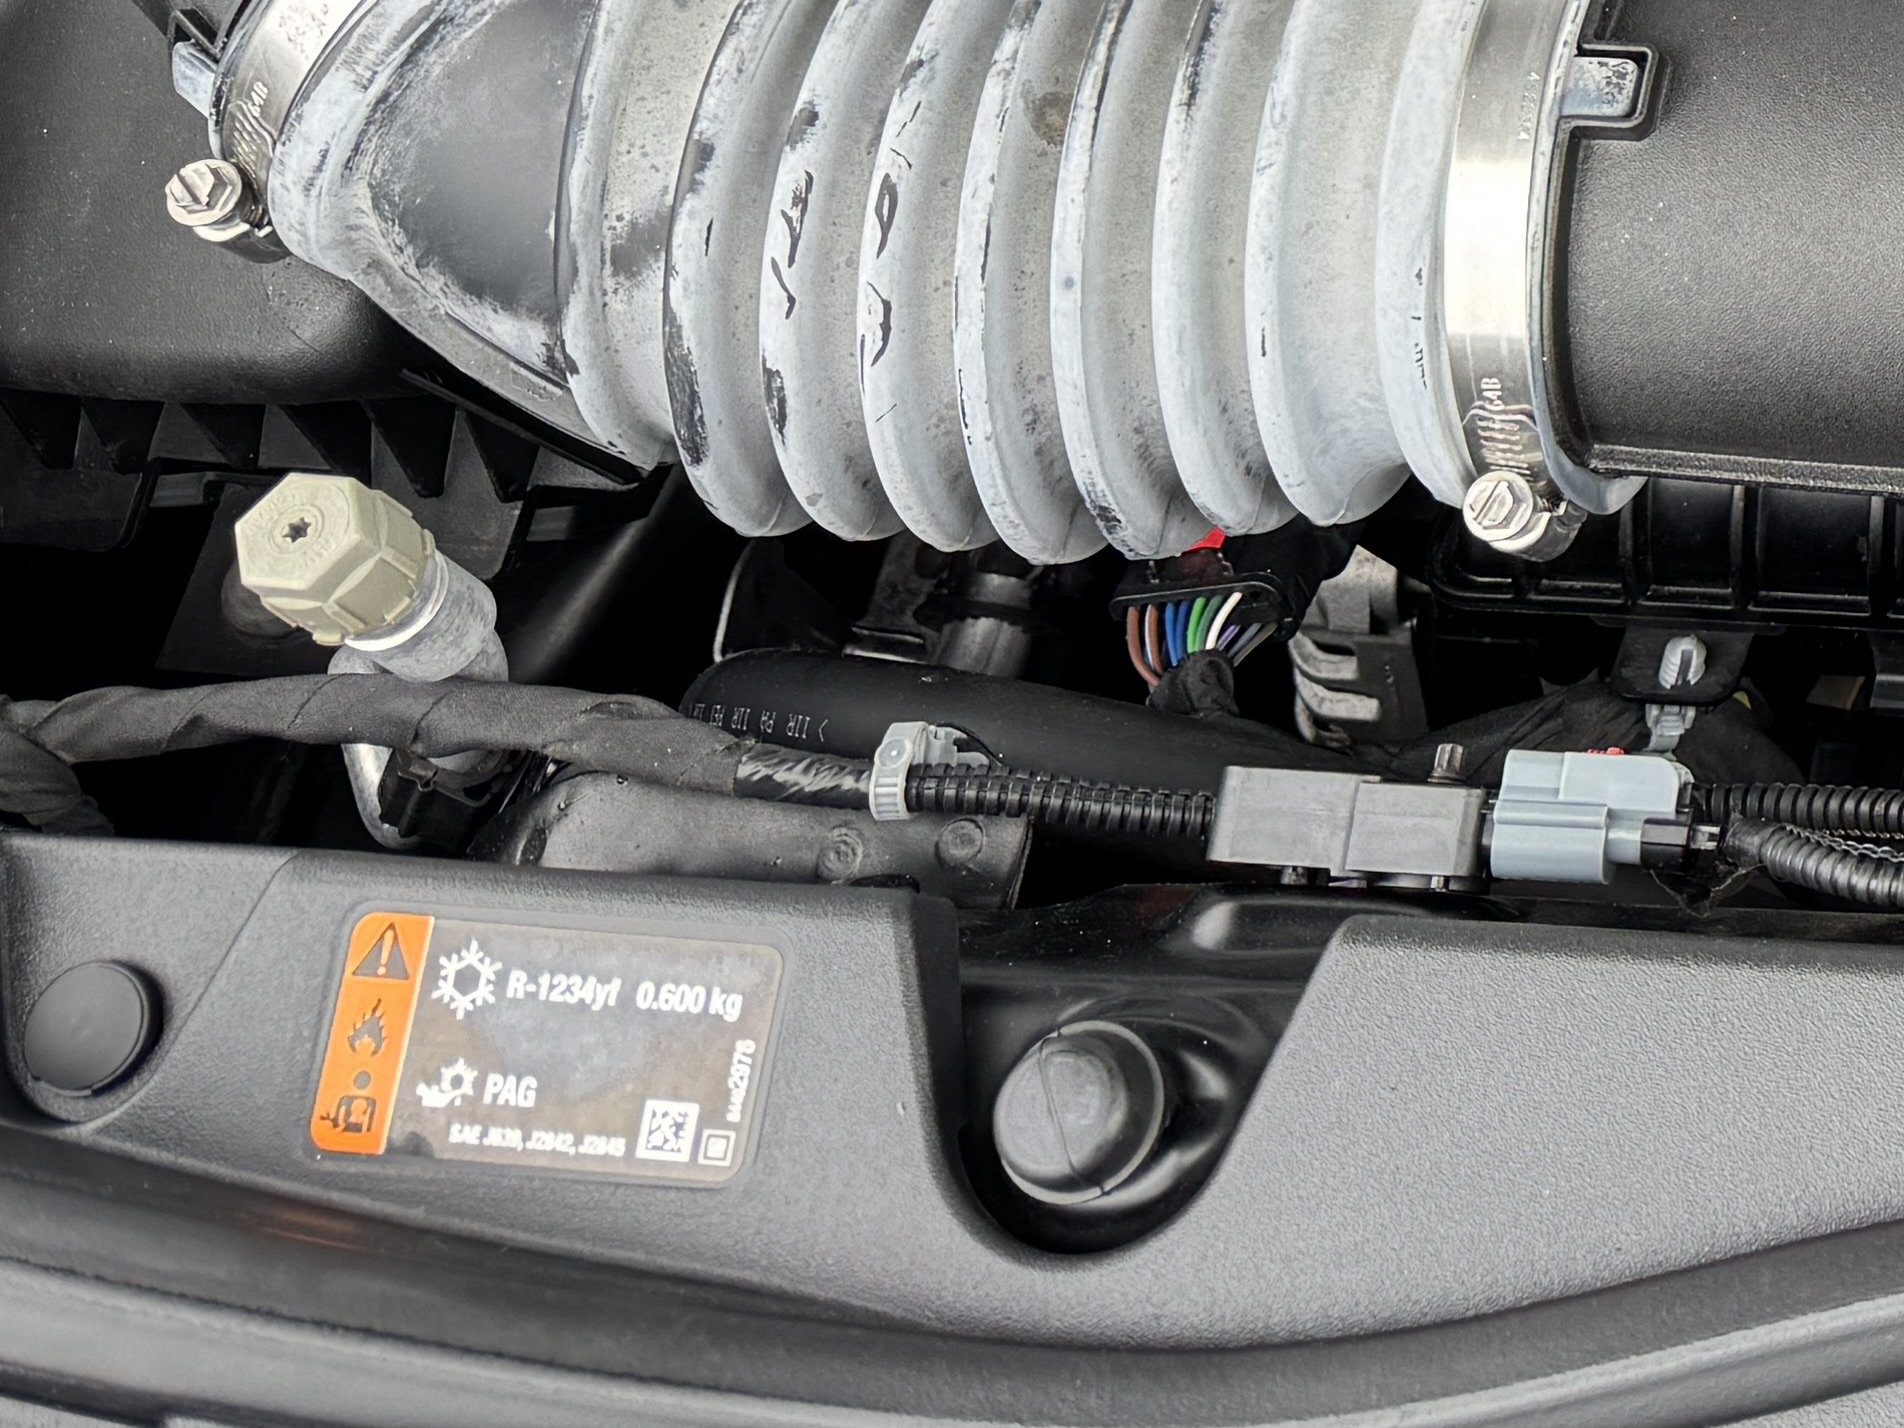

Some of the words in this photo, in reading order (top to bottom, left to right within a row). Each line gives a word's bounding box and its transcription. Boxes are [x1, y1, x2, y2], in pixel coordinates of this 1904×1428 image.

[506, 969, 622, 1011] R-1234yf
[636, 980, 706, 1014] 0.600
[708, 985, 743, 1022] kg
[483, 1072, 538, 1108] PAG
[449, 1123, 482, 1145] SAE
